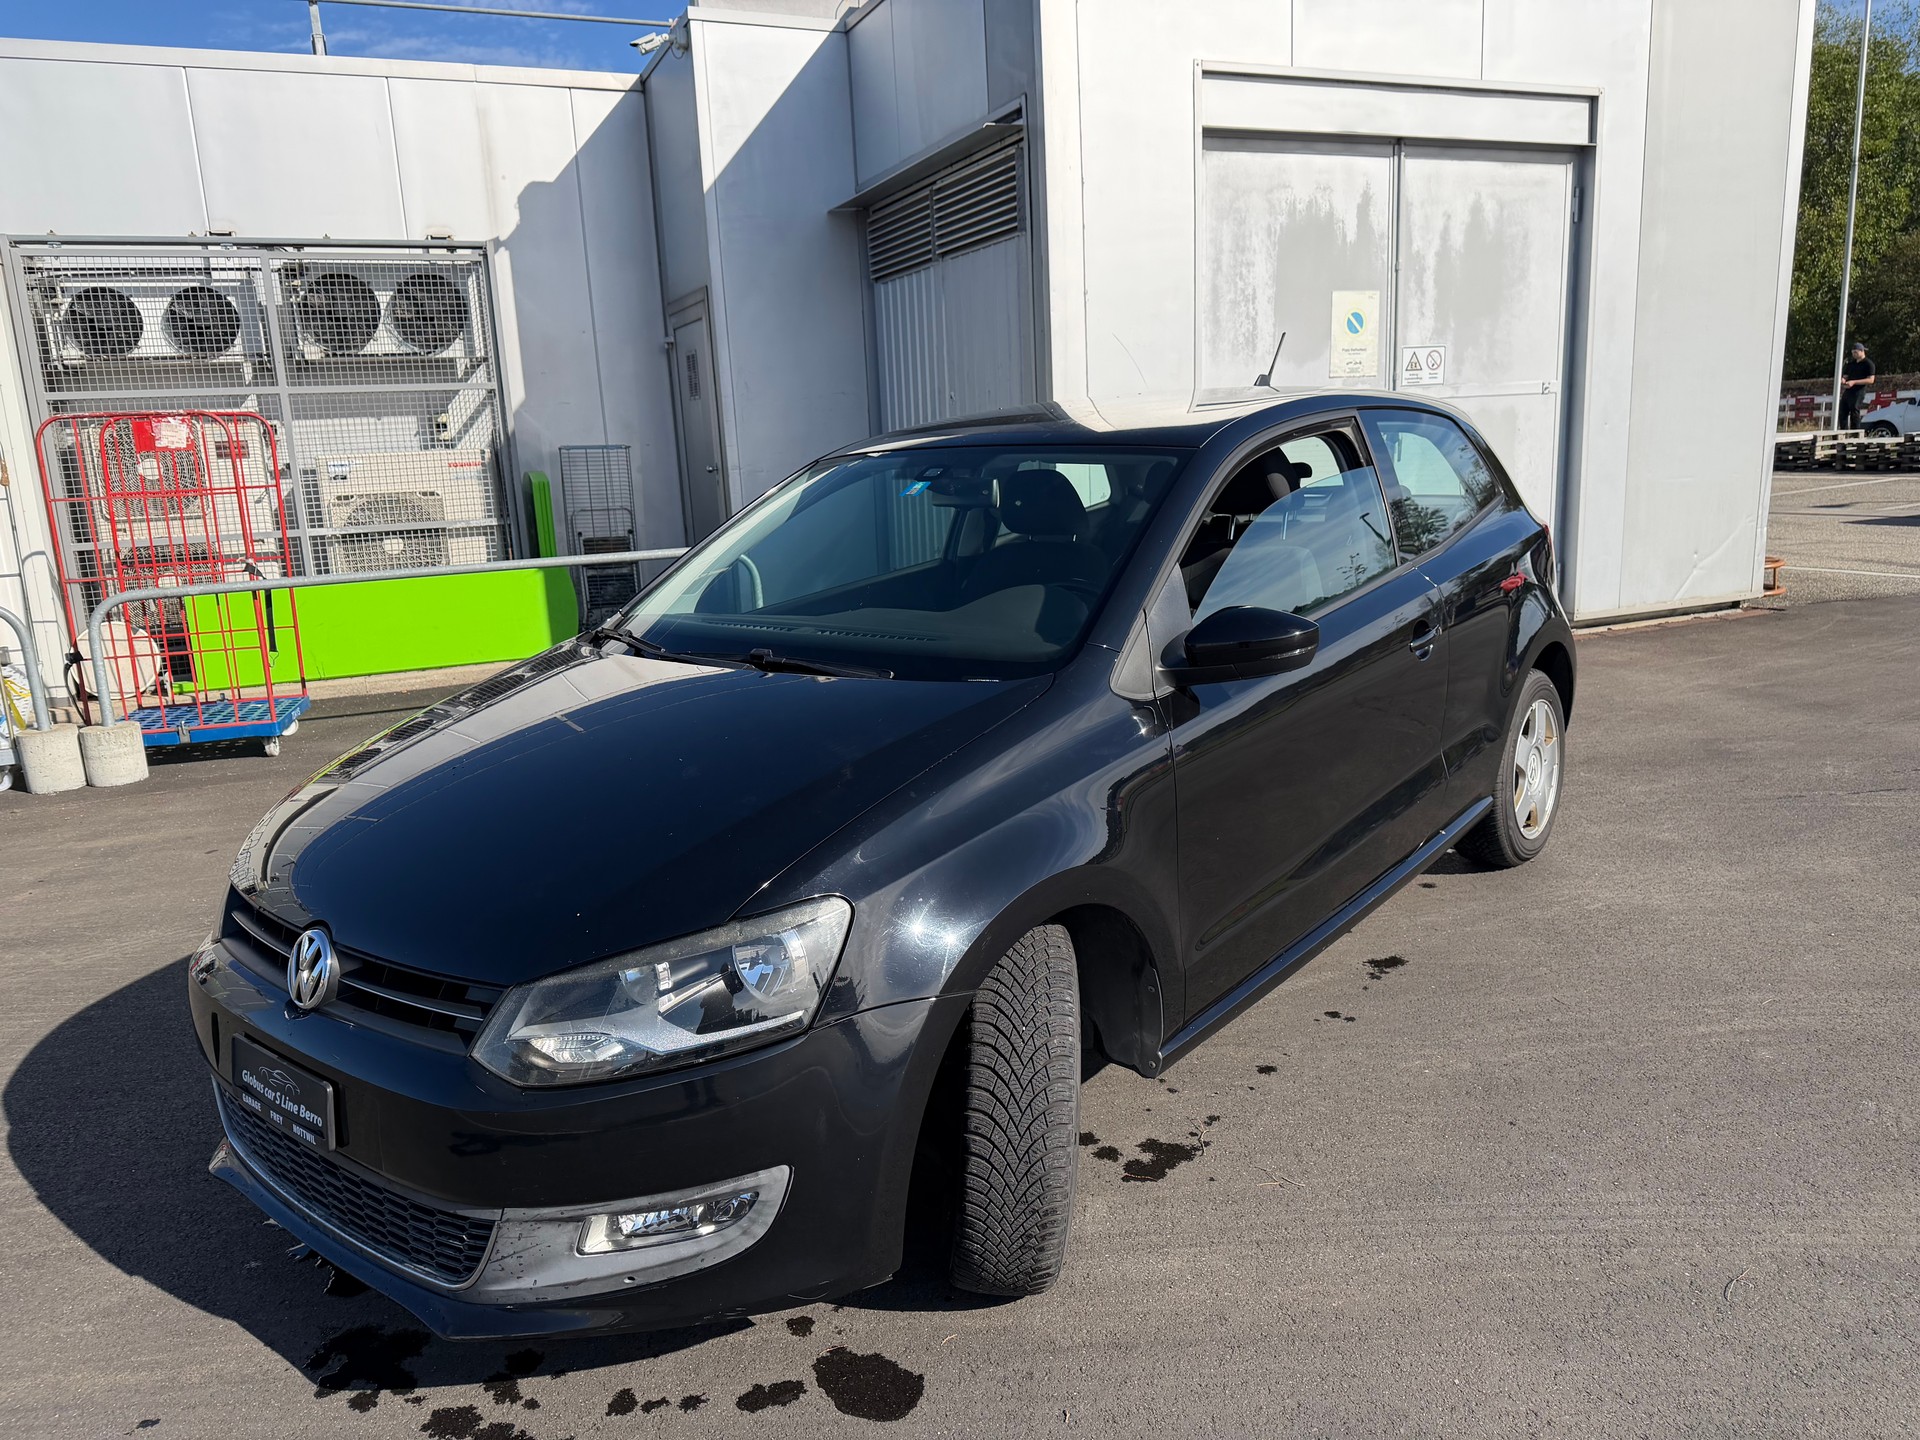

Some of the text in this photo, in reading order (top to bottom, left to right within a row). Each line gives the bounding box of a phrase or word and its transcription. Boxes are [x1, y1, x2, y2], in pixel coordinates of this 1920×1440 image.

[242, 1070, 323, 1127] Globus car S Line Berro
[242, 1093, 262, 1112] GARAGE
[270, 1110, 283, 1125] FREY
[292, 1124, 317, 1145] NOTTWIL
